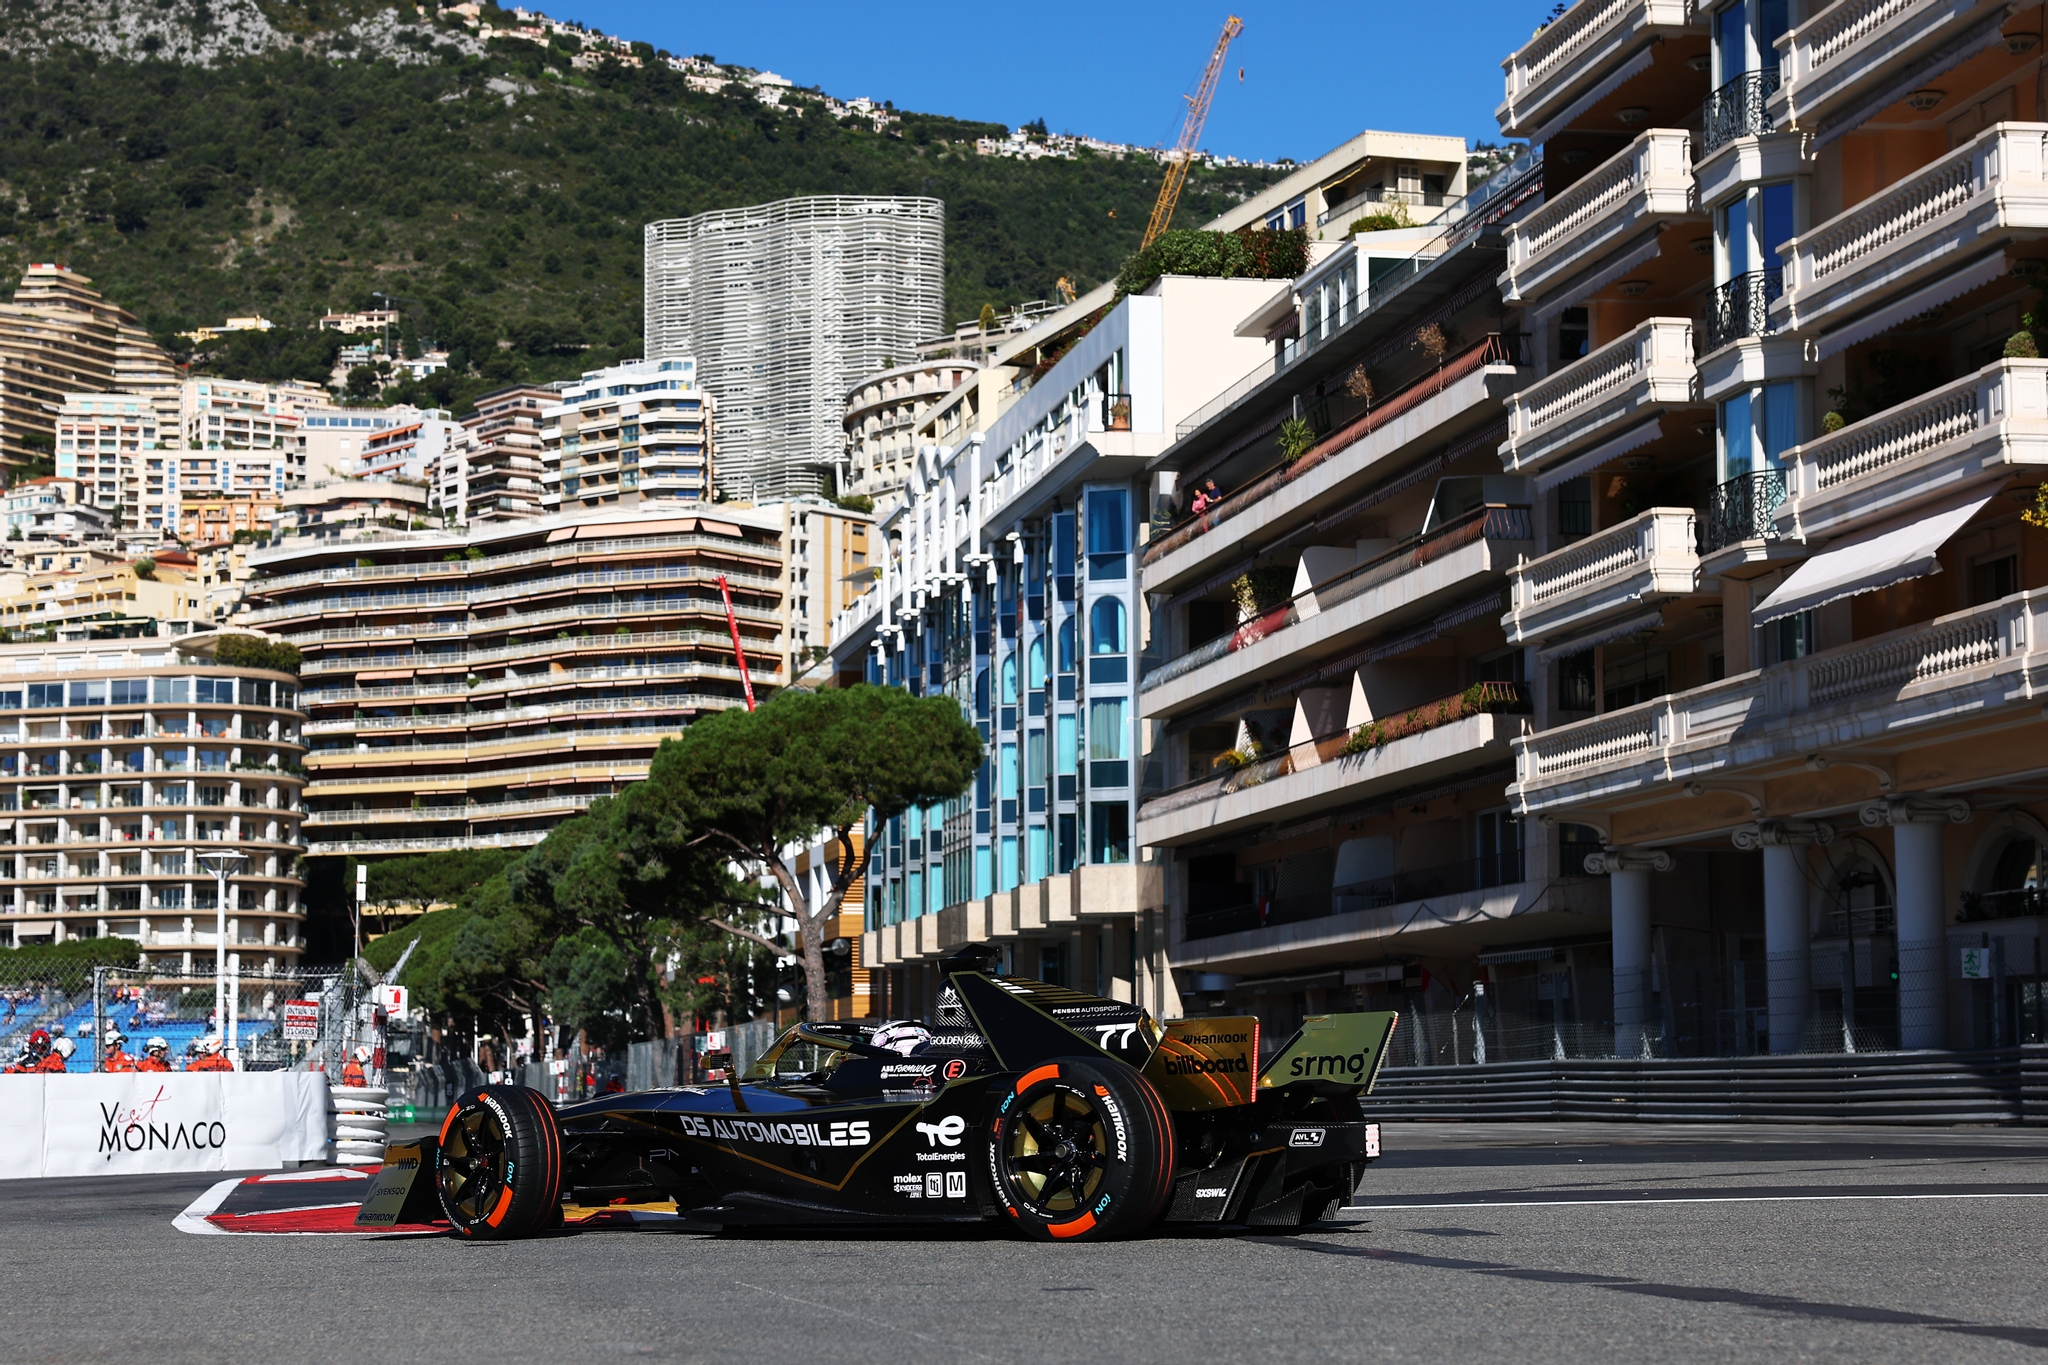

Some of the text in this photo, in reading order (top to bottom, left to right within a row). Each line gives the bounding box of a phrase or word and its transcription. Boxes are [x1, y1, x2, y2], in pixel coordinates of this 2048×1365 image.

[1081, 1005, 1121, 1013] AUTOSPORT
[929, 1035, 964, 1045] GOLDEN
[1095, 1023, 1137, 1051] 77
[1163, 1053, 1249, 1076] billboard
[100, 1085, 171, 1133] Visit
[98, 1121, 226, 1152] MONACO
[679, 1115, 871, 1147] DS AUTOMOBILES
[1295, 1133, 1310, 1141] AVL
[915, 1151, 966, 1162] TotalEnergies
[893, 1173, 922, 1184] molex
[949, 1174, 963, 1192] M
[1195, 1188, 1220, 1198] SXSW
